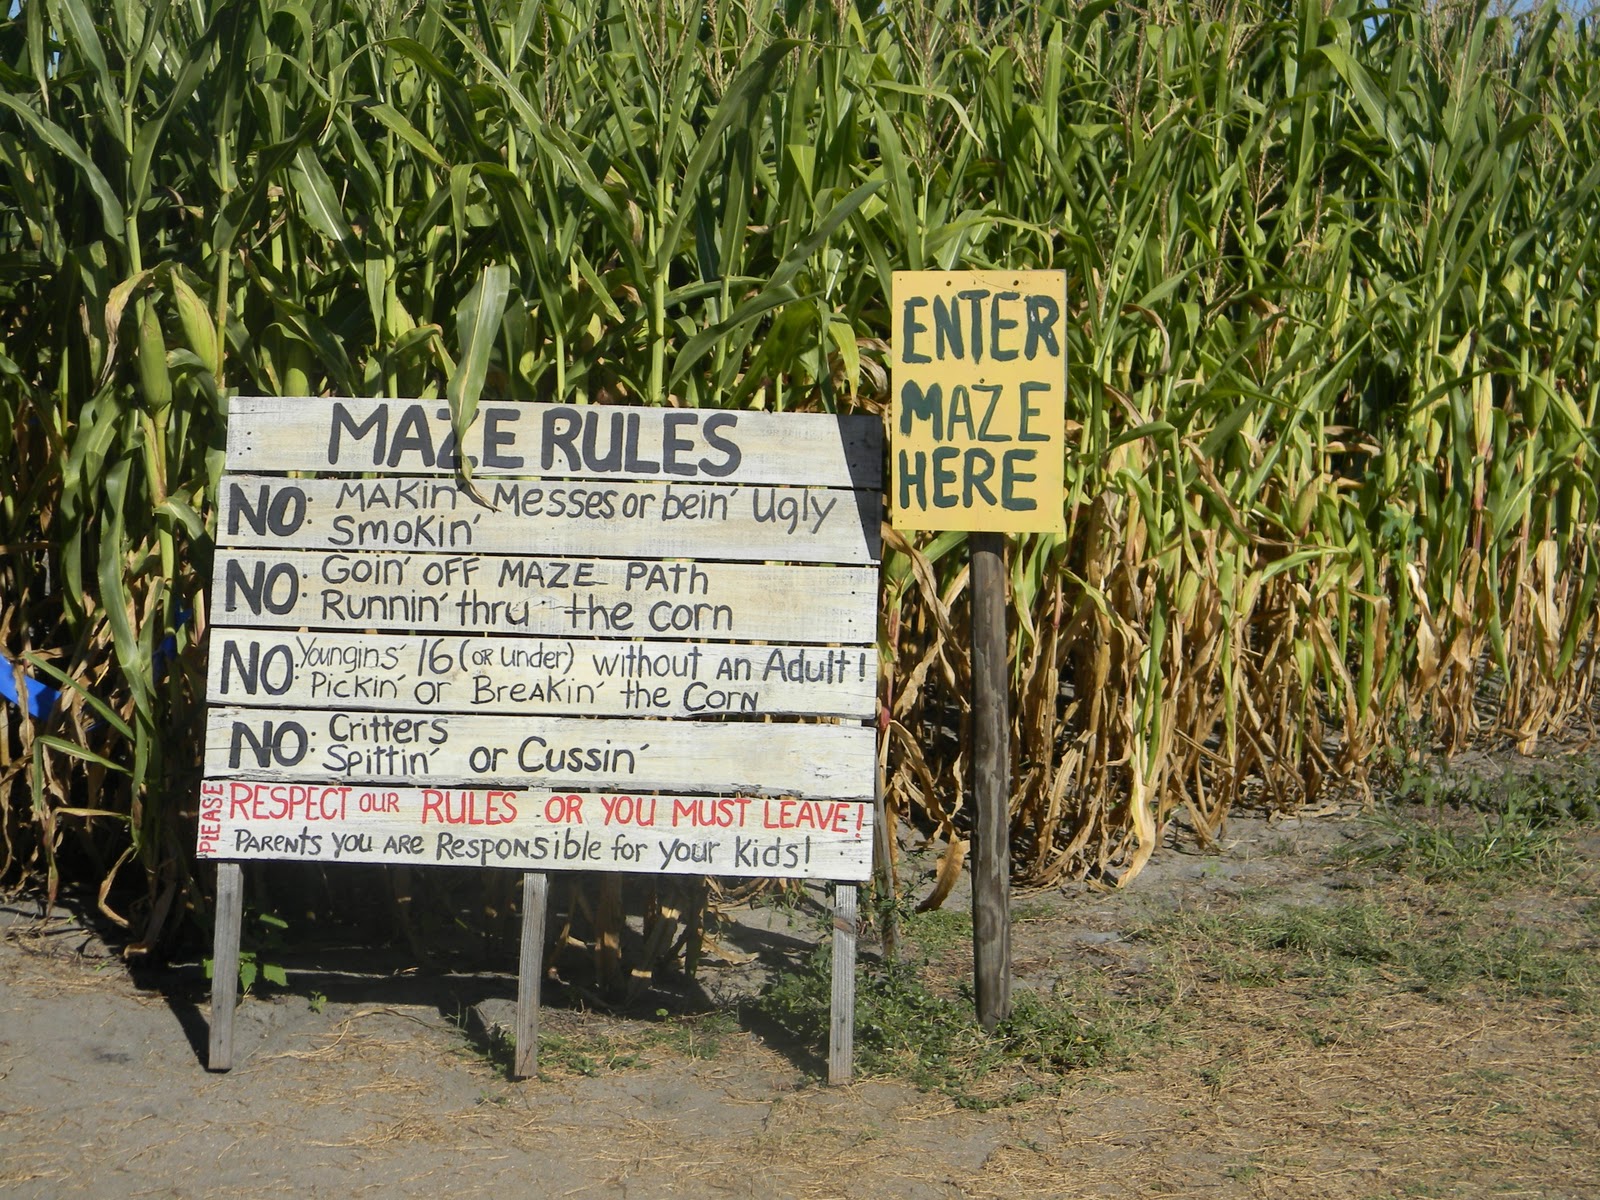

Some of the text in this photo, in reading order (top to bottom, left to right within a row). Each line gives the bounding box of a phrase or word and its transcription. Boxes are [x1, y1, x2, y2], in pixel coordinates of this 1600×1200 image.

[902, 289, 1060, 364] ENTER
[328, 402, 742, 477] MAZE RULES
[900, 379, 1051, 442] MAZE
[899, 447, 1038, 511] HERE
[227, 483, 313, 537] NO:
[492, 482, 618, 519] Messes
[622, 492, 656, 519] or
[662, 485, 739, 521] bein'
[225, 558, 308, 616] NO:
[321, 553, 411, 586] Goin'
[499, 559, 595, 589] MAZE
[321, 589, 449, 621] Runnin'
[455, 588, 530, 627] thru
[564, 593, 635, 631] the
[219, 640, 300, 697] NO:
[296, 635, 407, 673] Youngins'
[417, 638, 454, 677] 16
[592, 645, 702, 681] without
[762, 647, 867, 685] Adult!
[311, 670, 406, 699] Pickin'
[413, 680, 452, 705] or
[620, 679, 672, 710] the
[228, 712, 450, 770] NO: Critters
[321, 735, 650, 777] Spittin' or Cussin'
[199, 782, 224, 854] PLEASE
[229, 782, 865, 838] RESPECT OUR RULES OR YOU MUST LEAVE!
[610, 833, 648, 862] for
[658, 837, 721, 871] your
